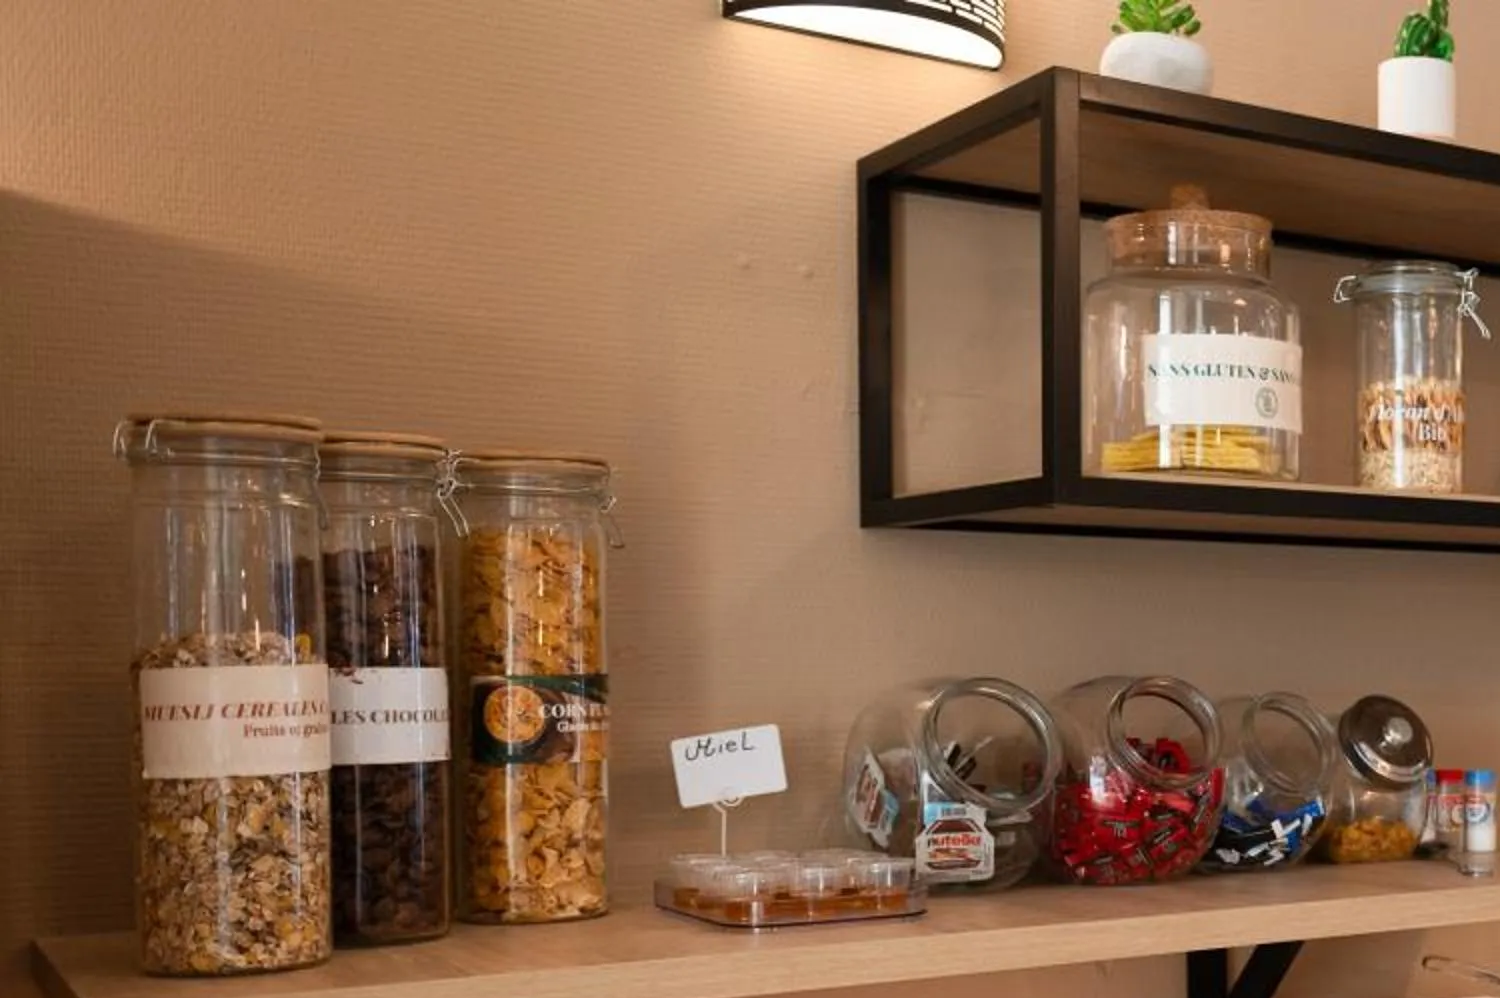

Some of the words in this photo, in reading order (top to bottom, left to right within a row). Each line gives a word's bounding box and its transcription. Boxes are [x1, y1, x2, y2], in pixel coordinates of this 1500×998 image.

[1149, 363, 1191, 378] SNS
[1192, 362, 1255, 378] GLUTEN
[1419, 422, 1446, 440] Bio
[927, 833, 984, 848] nutella
